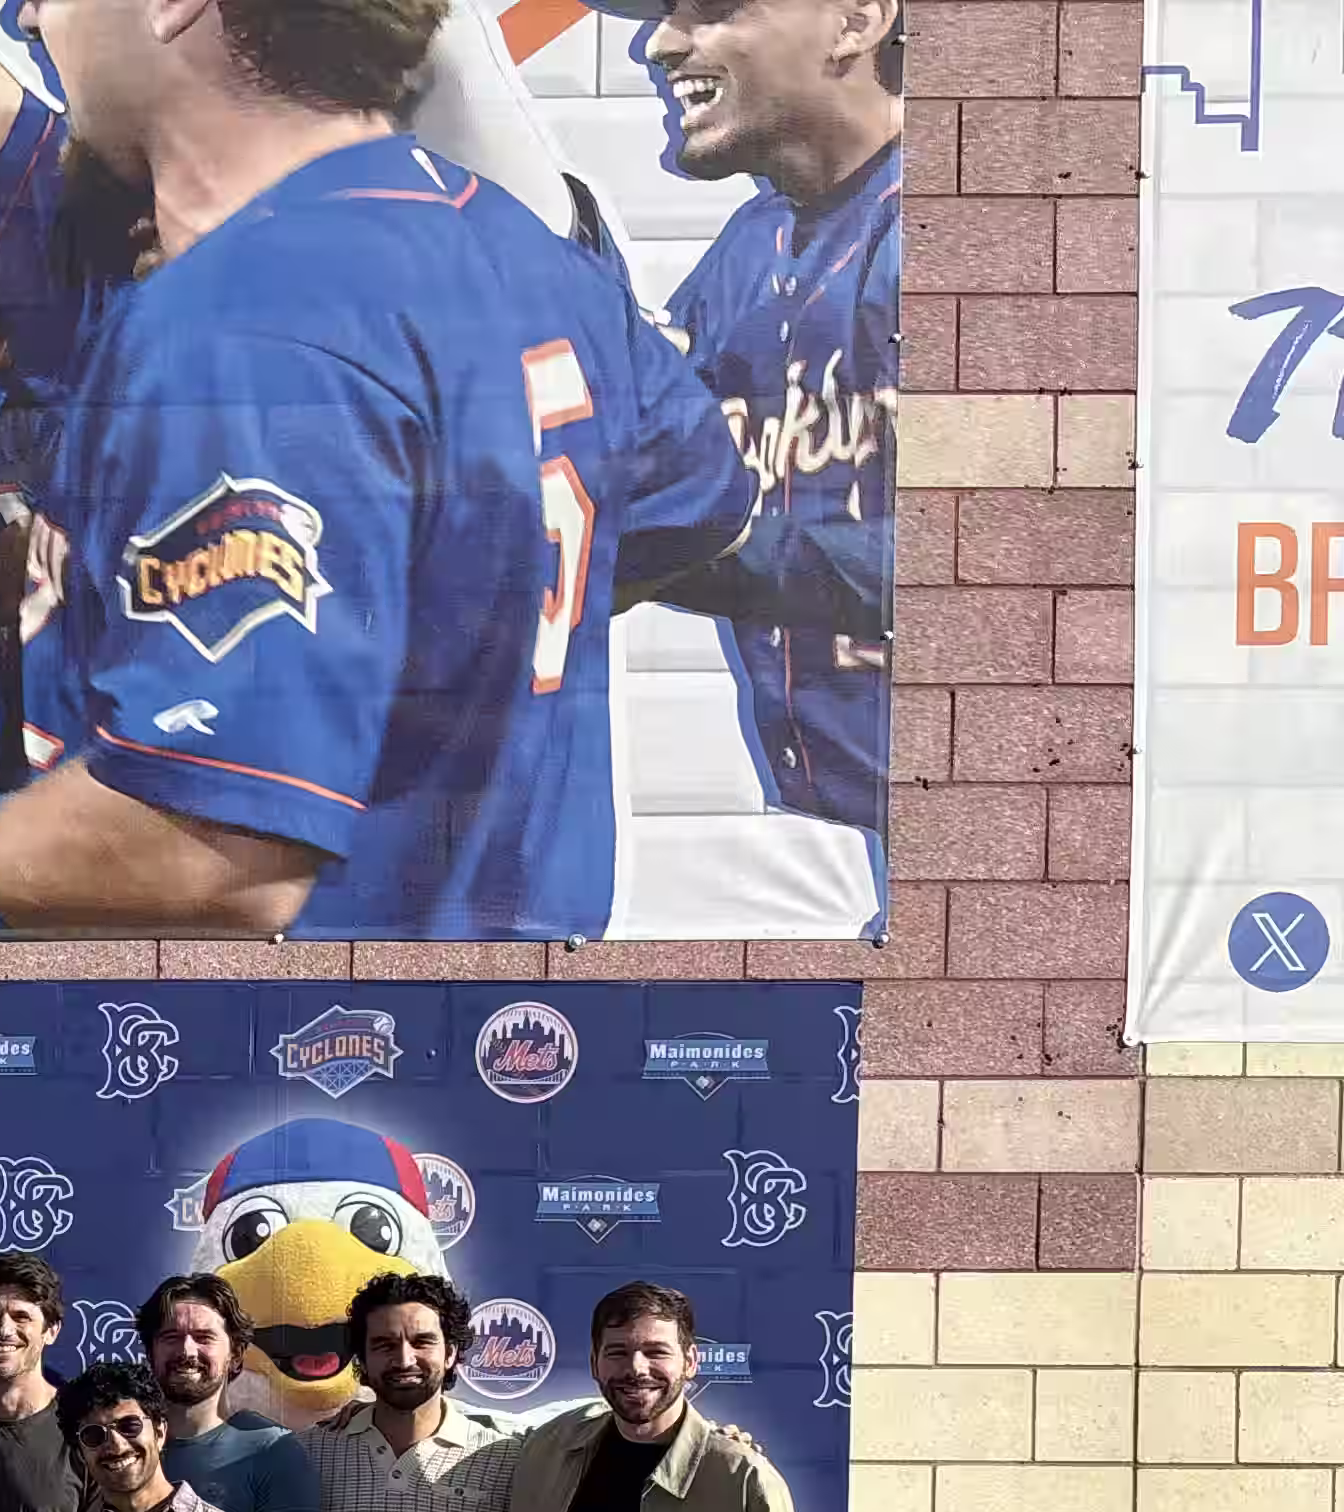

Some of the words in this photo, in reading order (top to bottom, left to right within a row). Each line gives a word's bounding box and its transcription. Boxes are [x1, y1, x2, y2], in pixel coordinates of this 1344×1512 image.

[286, 1034, 385, 1071] CYCLONES
[493, 1039, 561, 1071] Mets
[650, 1044, 764, 1059] Maimonides
[542, 1187, 655, 1202] Maimonides
[472, 1336, 536, 1367] Mets
